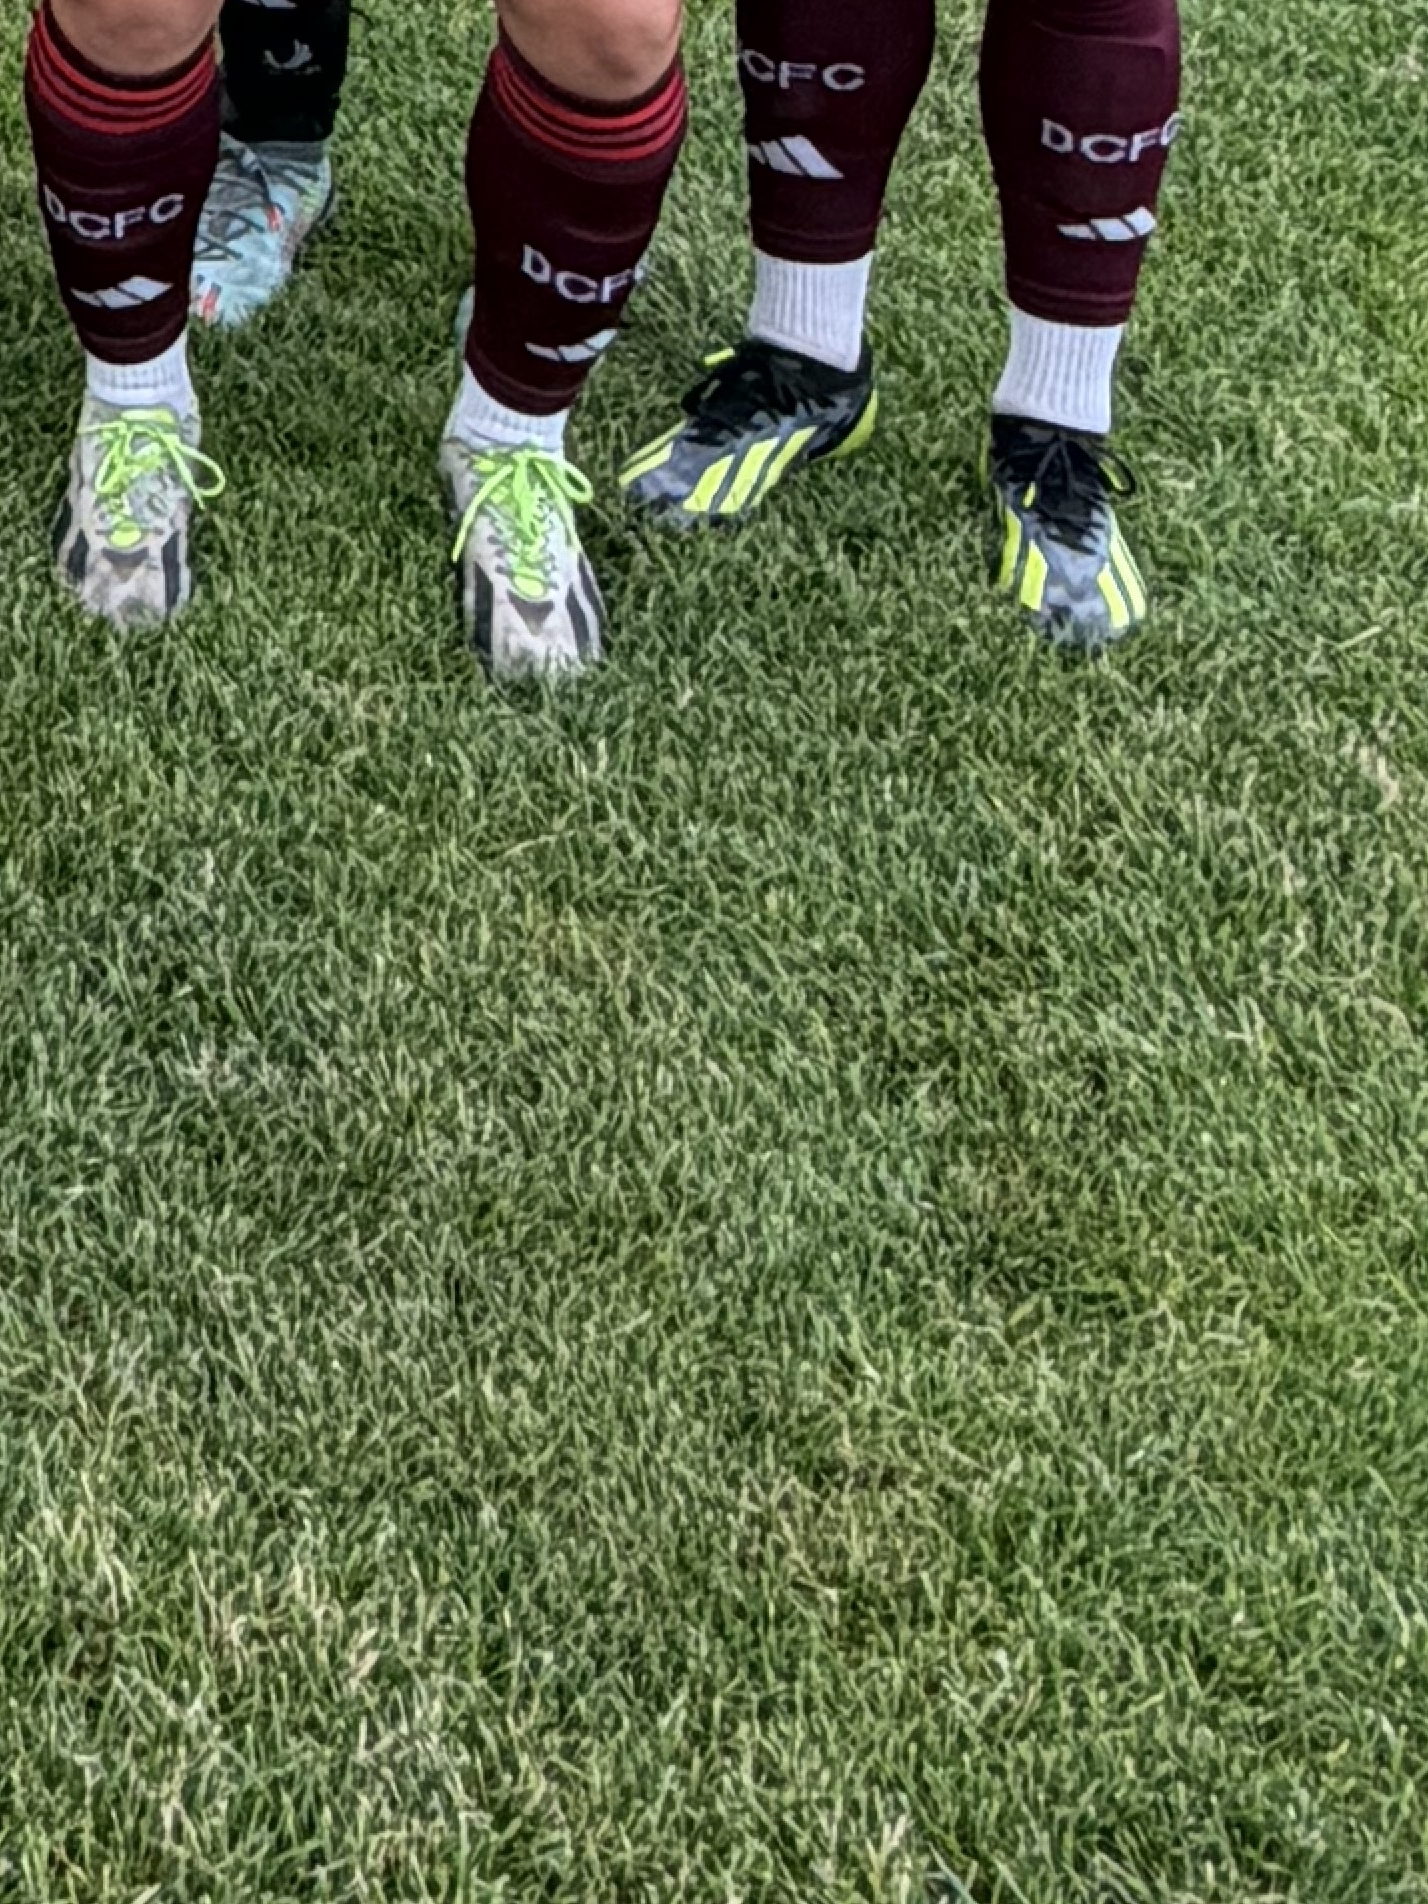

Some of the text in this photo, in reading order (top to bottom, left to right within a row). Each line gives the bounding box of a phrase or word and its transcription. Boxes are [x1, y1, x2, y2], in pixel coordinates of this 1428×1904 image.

[739, 49, 865, 91] CFC
[42, 183, 185, 241] DCFC
[520, 243, 642, 304] DCF
